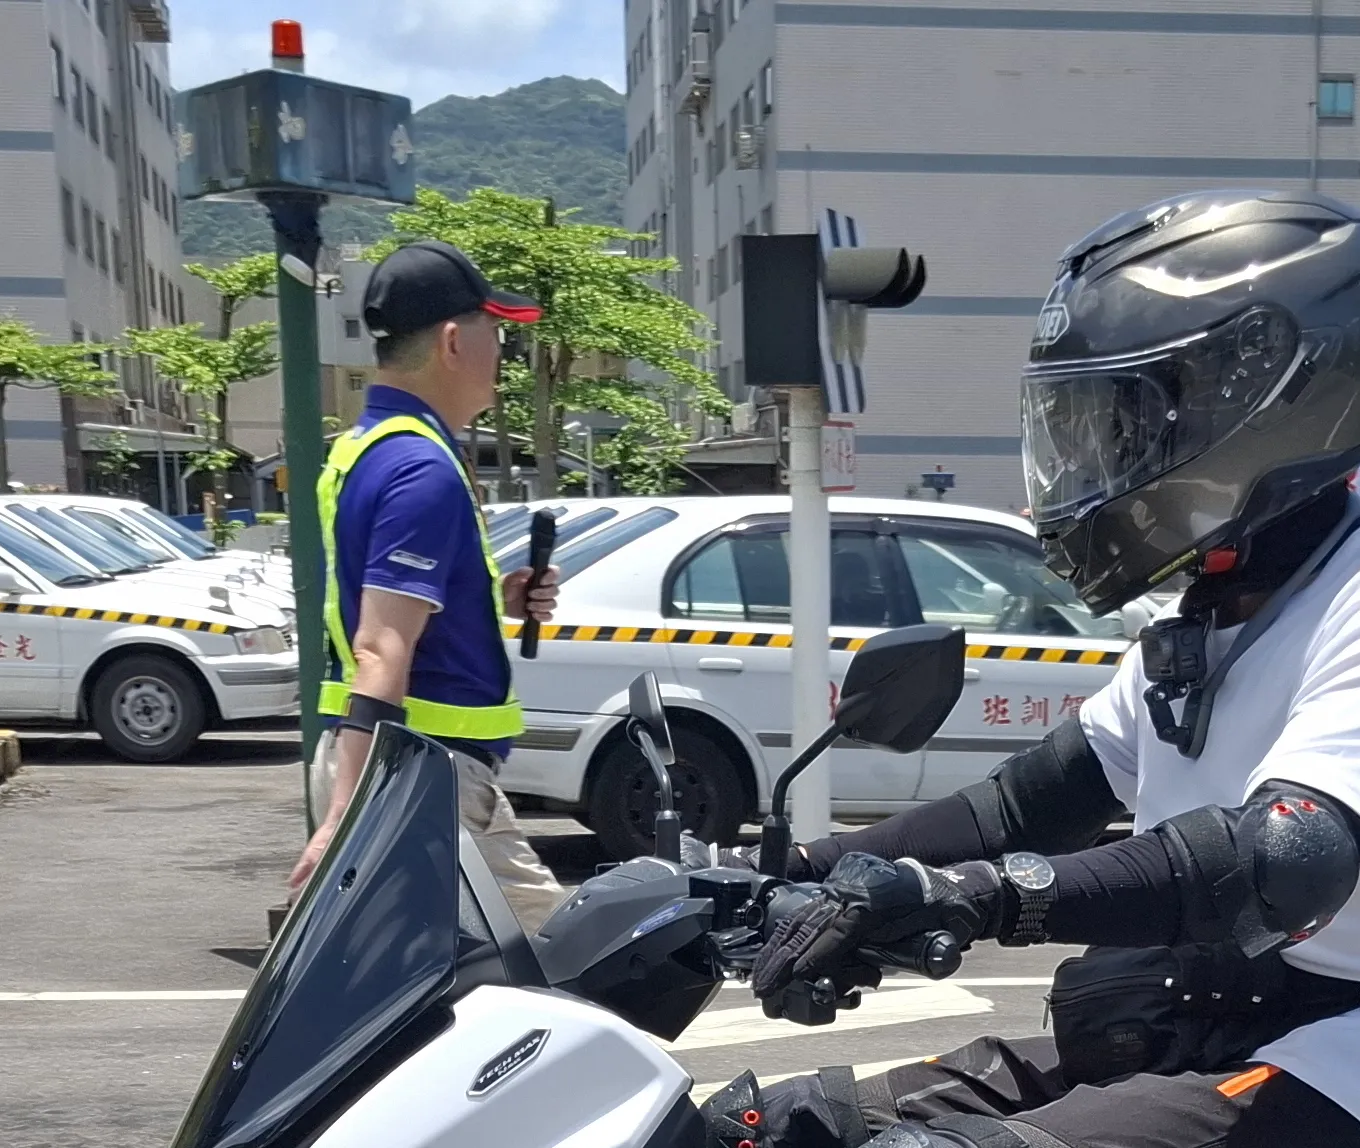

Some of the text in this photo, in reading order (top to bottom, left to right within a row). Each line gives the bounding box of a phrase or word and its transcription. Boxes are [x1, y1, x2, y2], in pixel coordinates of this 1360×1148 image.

[1036, 311, 1063, 338] OEI
[478, 1036, 541, 1083] TECH MAX
